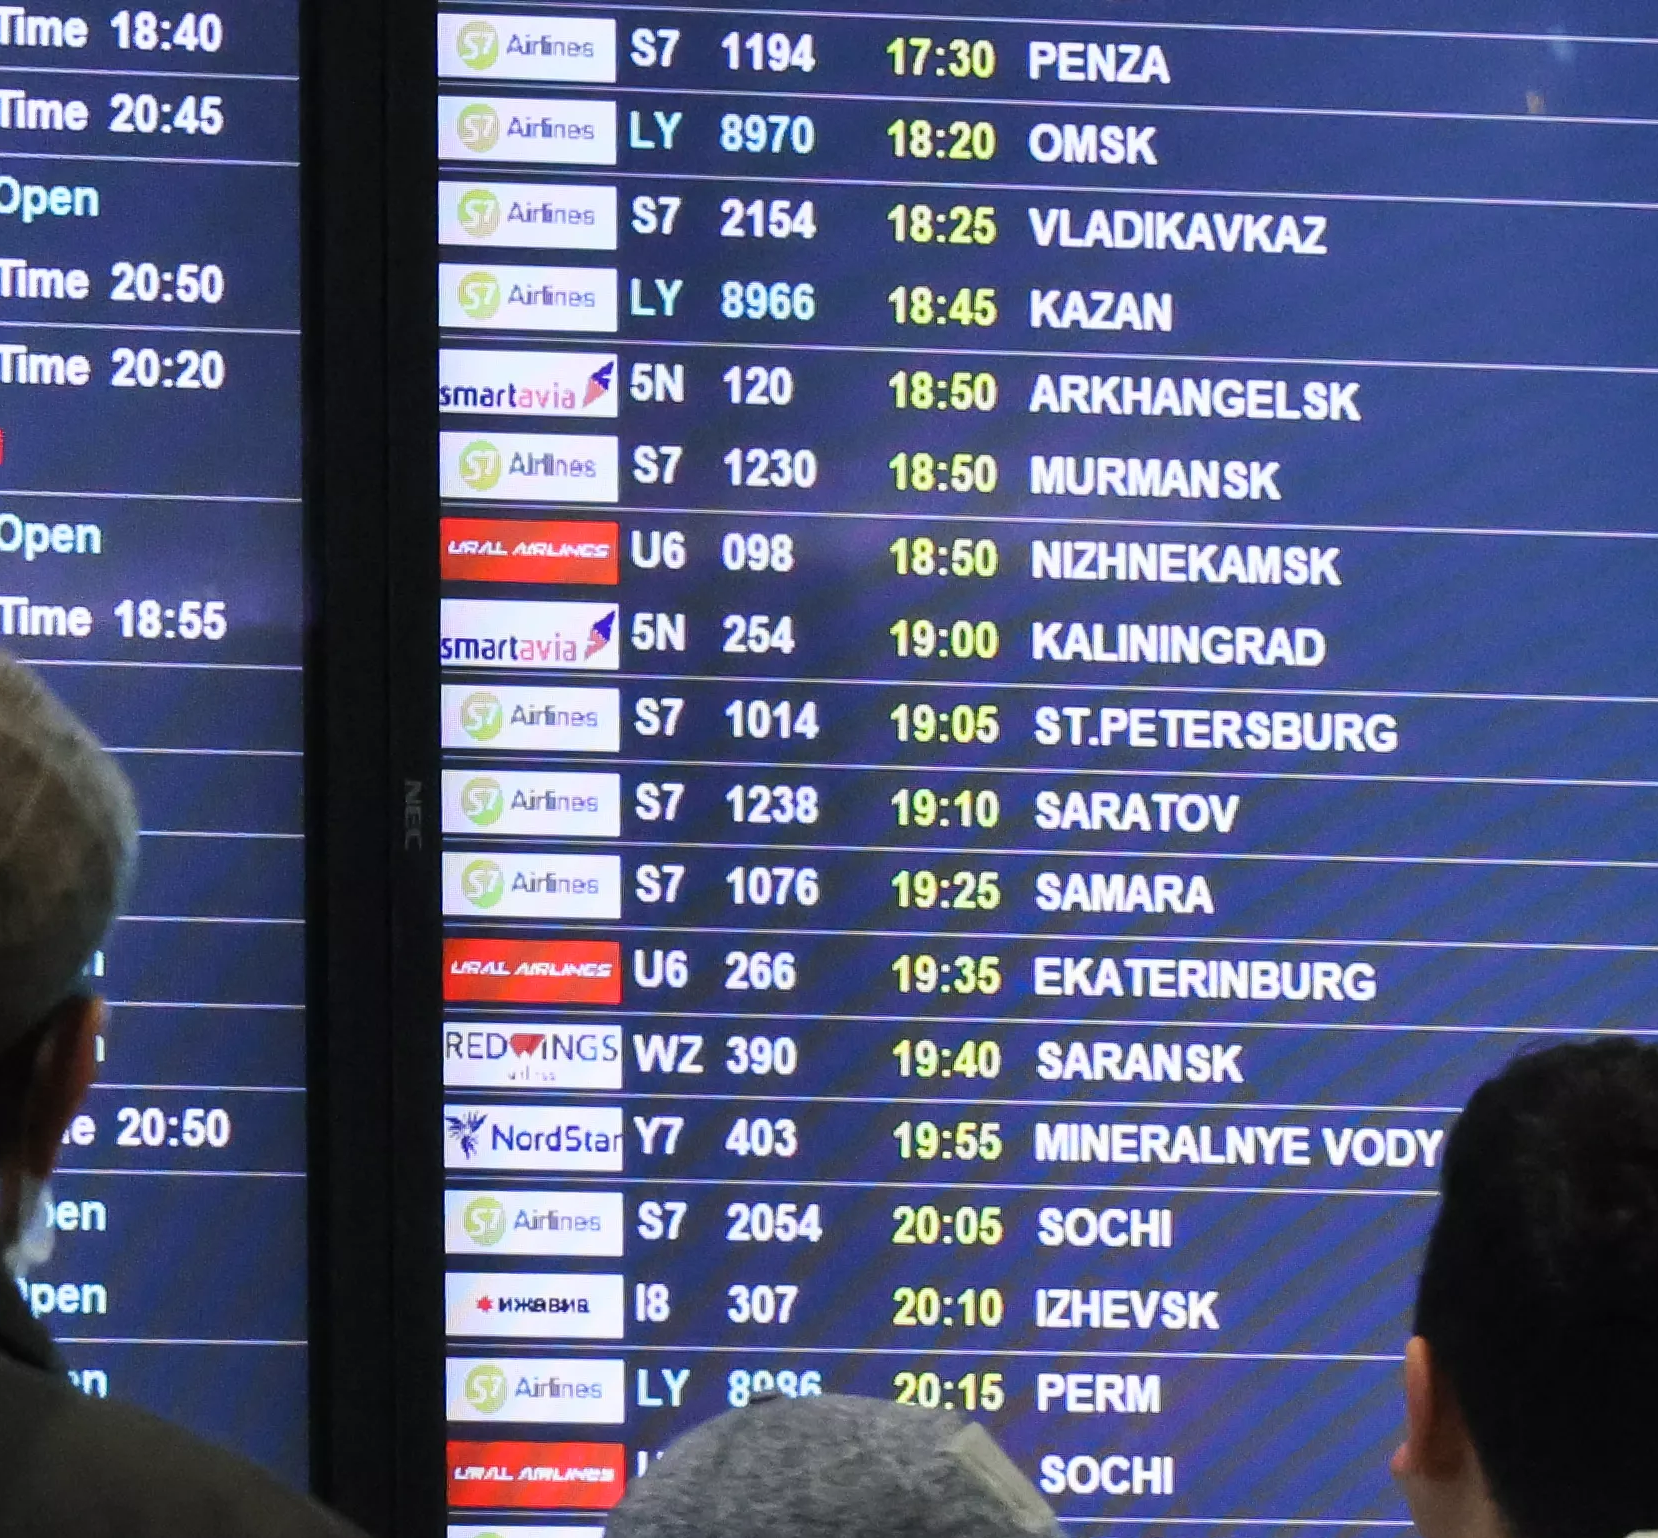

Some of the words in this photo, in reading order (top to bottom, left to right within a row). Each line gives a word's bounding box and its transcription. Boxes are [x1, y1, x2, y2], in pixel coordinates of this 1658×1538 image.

[111, 11, 222, 52] 18:40
[631, 28, 680, 67] S7
[722, 32, 815, 72] 1194
[887, 38, 995, 77] 17:30
[1030, 41, 1170, 84] PENZA
[632, 196, 681, 234] S7
[721, 199, 816, 239] 2154
[888, 204, 996, 244] 18:25
[1029, 208, 1327, 254] VLADIKAVKAZ
[111, 262, 224, 303] 20:50
[111, 348, 224, 389] 20:20
[440, 382, 576, 409] smartavia
[631, 363, 683, 402] 5N
[724, 366, 793, 405] 120
[889, 371, 997, 411] 18:50
[1029, 374, 1361, 421] ARKHANGELSK
[512, 542, 610, 559] AIRLINES
[632, 531, 685, 569] U6
[723, 533, 794, 571] 098
[890, 537, 998, 576] 18:50
[1032, 540, 1342, 586] NIZHNEKAMSK
[114, 599, 227, 640] 18:55
[632, 613, 685, 651] 5N
[724, 615, 795, 654] 254
[890, 619, 999, 658] 19:00
[1033, 622, 1326, 666] KALININGRAD
[442, 633, 577, 662] smartavia
[635, 698, 683, 736] S7
[726, 700, 819, 739] 1014
[891, 704, 999, 743] 19:05
[1035, 707, 1398, 752] ST.PETERSBURG
[404, 779, 422, 851] NEC
[450, 960, 511, 976] URAL
[514, 962, 613, 978] AIRLINES
[635, 950, 688, 988] U6
[726, 951, 796, 990] 266
[892, 955, 1001, 994] 19:35
[1035, 957, 1376, 1001] EKATERINBURG
[633, 1035, 703, 1073] WZ
[727, 1036, 797, 1075] 390
[893, 1040, 1001, 1078] 19:40
[1037, 1041, 1244, 1083] SARANSK
[117, 1107, 230, 1147] 20:50
[492, 1122, 623, 1152] NordStar
[634, 1116, 684, 1154] Y7
[726, 1118, 797, 1157] 403
[894, 1121, 1002, 1160] 19:55
[1035, 1123, 1311, 1165] MINERALNYE
[1322, 1128, 1444, 1167] VODY
[636, 1283, 670, 1321] I8
[728, 1285, 798, 1323] 307
[893, 1287, 1004, 1326] 20:10
[1036, 1289, 1219, 1329] IZHEVSK
[1040, 1455, 1175, 1495] SOCHI
